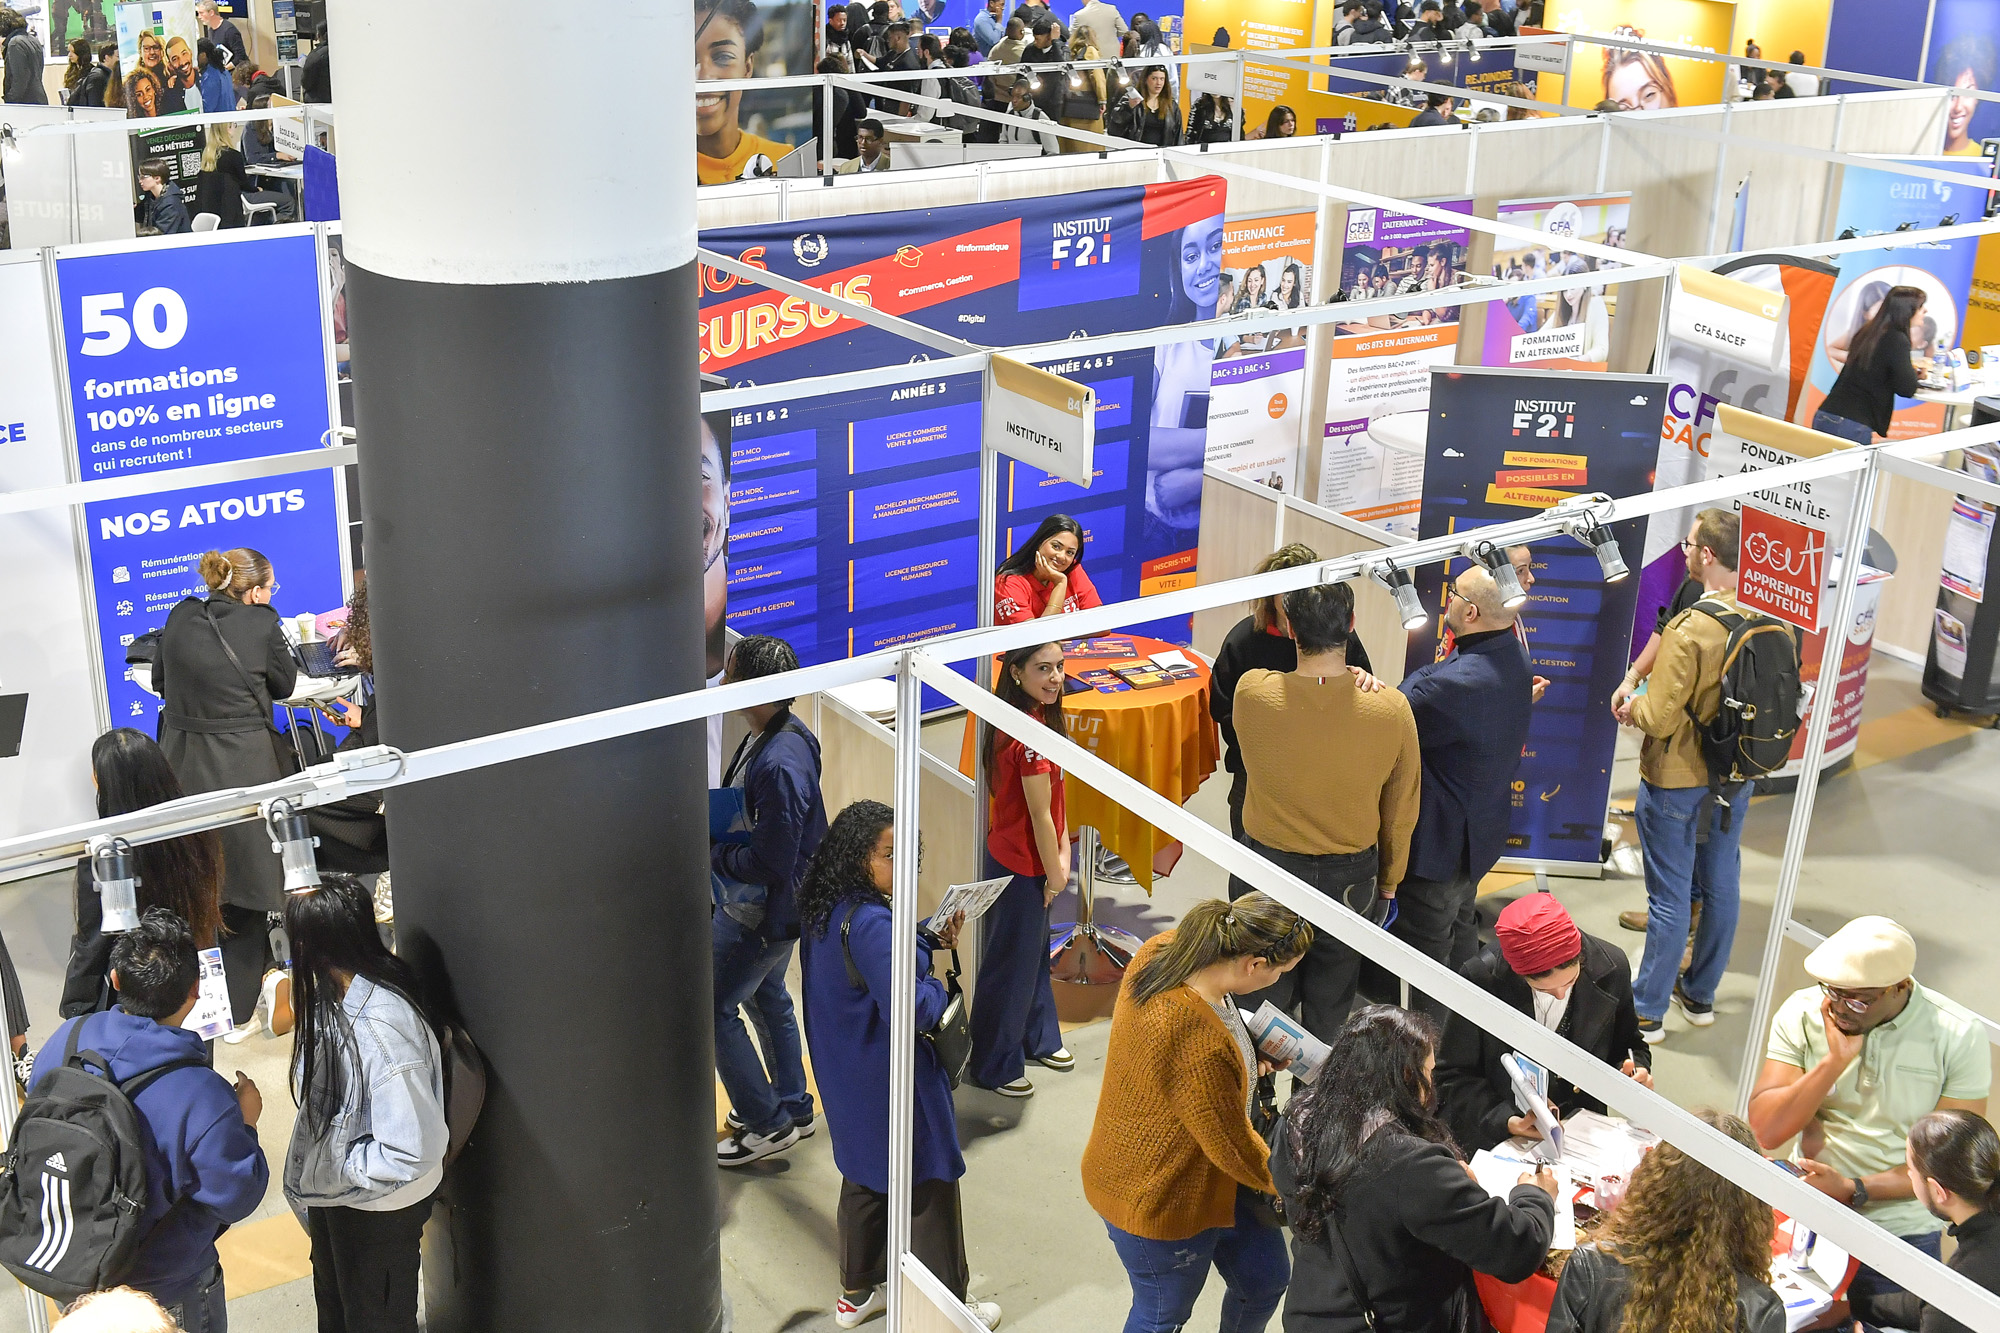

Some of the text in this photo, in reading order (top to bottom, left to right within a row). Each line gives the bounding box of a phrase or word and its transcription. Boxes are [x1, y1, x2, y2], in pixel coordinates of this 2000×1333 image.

[1204, 72, 1218, 80] EPIDE
[1465, 70, 1514, 84] REJOINDRE
[150, 140, 194, 154] NOS MÉTIERS
[1052, 216, 1112, 238] INSTITUT
[1349, 222, 1370, 234] CFA
[1382, 219, 1424, 230] L'ALTERNANCE
[1550, 221, 1571, 232] CFA
[1222, 225, 1285, 244] ALTERNANCE
[1348, 232, 1372, 241] SACEF
[956, 242, 1010, 252] #Informatique
[1227, 238, 1311, 254] voie d'avenir et d'excellence
[898, 274, 974, 297] #Commerce, Gestion
[80, 286, 188, 357] 50
[958, 314, 986, 324] #Digital
[1522, 332, 1576, 346] FORMATIONS
[1694, 322, 1746, 347] CFA SACEF
[1356, 334, 1438, 352] NOS BTS EN ALTERNANCE
[1514, 344, 1580, 358] EN ALTERNANCE
[1083, 360, 1092, 370] 4
[1106, 356, 1114, 366] 5
[1232, 367, 1237, 376] 3
[1244, 364, 1258, 374] BAC
[1265, 362, 1270, 370] 5
[1359, 364, 1386, 372] formations
[84, 366, 238, 400] formations
[1357, 382, 1388, 392] l'expérience
[1388, 376, 1427, 388] professionnelle
[890, 382, 946, 402] ANNÉE 3
[1356, 393, 1372, 402] métier
[1380, 390, 1390, 398] des
[1390, 388, 1416, 397] poursuites
[87, 392, 276, 432] 100% en ligne
[1067, 397, 1080, 414] B4
[1514, 400, 1576, 414] INSTITUT
[1668, 384, 1720, 428] CF
[756, 407, 788, 423] 1 2
[886, 425, 948, 441] LICENCE COMMERCE
[1006, 420, 1048, 448] INSTITUT
[1329, 422, 1364, 434] Des secteurs
[91, 418, 284, 454] dans de nombreux secteurs
[886, 432, 948, 448] VENTE MARKETING
[1661, 415, 1712, 458] SAC
[1230, 439, 1254, 448] COMMERCE
[732, 447, 762, 458] BTS MCO
[93, 449, 184, 474] qui recrutent
[734, 456, 760, 465] Commercial
[1249, 462, 1256, 470] et
[1257, 460, 1265, 468] un
[1266, 456, 1286, 466] salaire
[1529, 456, 1578, 466] FORMATIONS
[1506, 472, 1575, 483] POSSIBLES EN
[732, 487, 764, 498] BTS NDRC
[1504, 491, 1562, 504] ALTERNAN
[874, 490, 958, 511] BACHELOR MERCHANDISING
[100, 489, 305, 540] NOS ATOUTS
[878, 498, 960, 518] MANAGEMENT COMMERCIAL
[1784, 497, 1802, 513] EN
[1806, 500, 1830, 520] ÎLE-
[728, 526, 784, 542] COMMUNICATION
[141, 552, 204, 568] Rémunération
[1153, 555, 1192, 572] INSCRIS-TOI
[1530, 562, 1548, 570] DRC
[142, 565, 189, 580] mensuelle
[735, 565, 762, 576] BTS SAM
[884, 559, 948, 578] LICENCE RESSOURCES
[901, 570, 932, 582] HUMAINES
[1159, 579, 1175, 589] VITE
[1744, 568, 1813, 605] APPRENTIS
[144, 588, 192, 602] Réseau de
[1526, 594, 1569, 603] NICATION
[1743, 582, 1812, 621] D'AUTEUIL
[768, 600, 795, 612] GESTION
[874, 634, 906, 647] BACHELOR
[907, 622, 956, 640] ADMINISTRATEUR
[1540, 659, 1576, 667] GESTION
[46, 1159, 68, 1173] adidas
